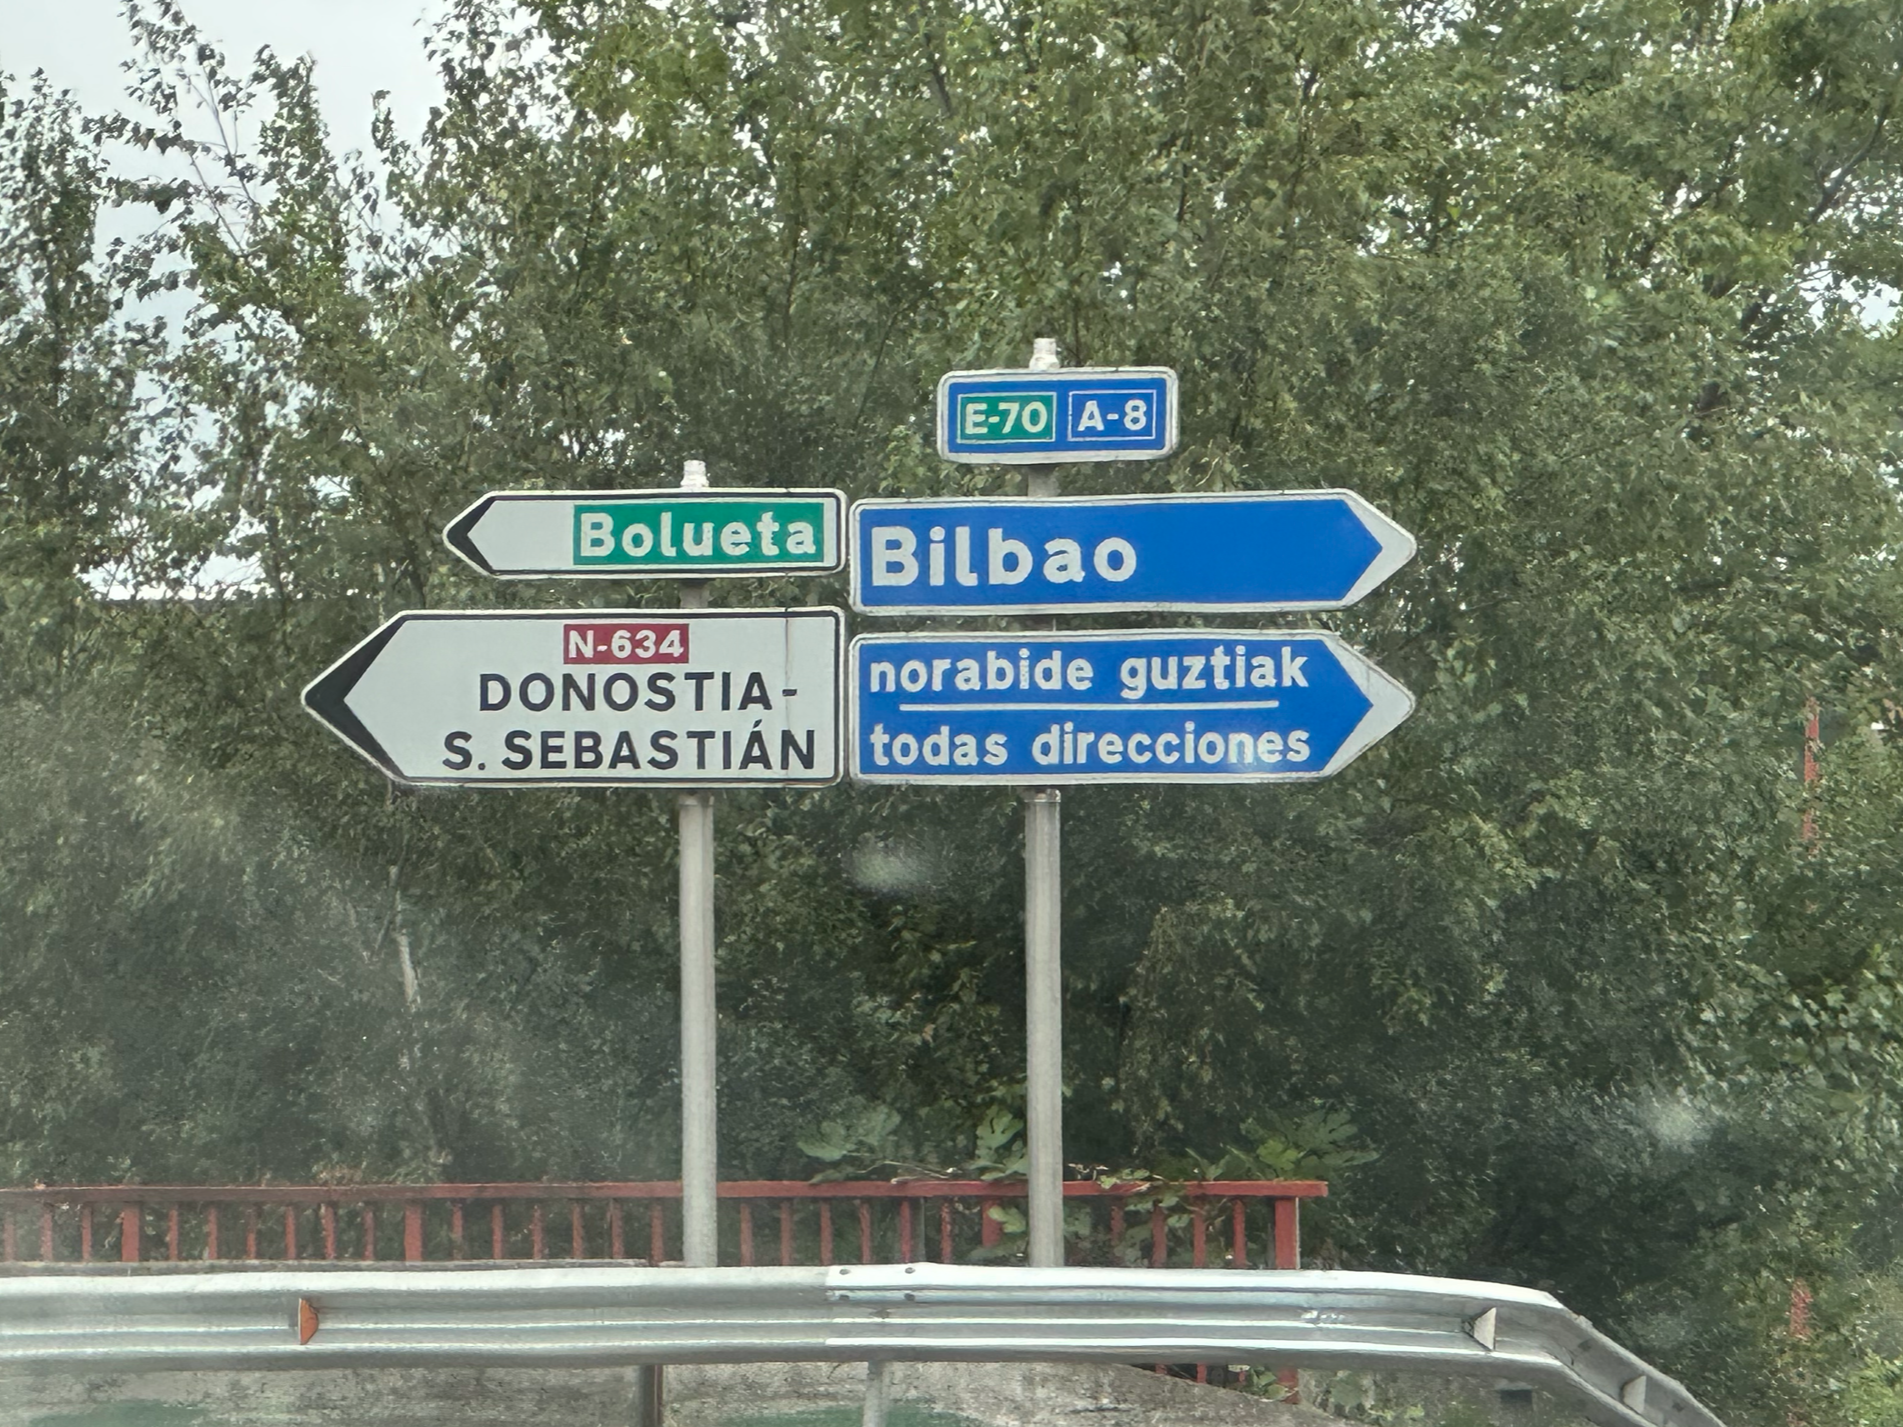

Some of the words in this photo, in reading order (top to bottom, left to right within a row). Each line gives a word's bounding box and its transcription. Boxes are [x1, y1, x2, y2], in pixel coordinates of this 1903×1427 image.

[964, 401, 1049, 435] E-70
[1077, 399, 1148, 431] A-8
[579, 511, 817, 558] Bolueta
[870, 525, 1137, 587] Bilbao
[567, 629, 685, 659] N-634
[479, 671, 799, 712] DONOSTIA-
[869, 647, 1095, 693] norabide
[1119, 644, 1310, 700] guztiak
[442, 731, 486, 771] S.
[501, 719, 816, 771] SEBASTIÁN
[870, 723, 1008, 766] todas
[1031, 721, 1312, 766] direcciones
